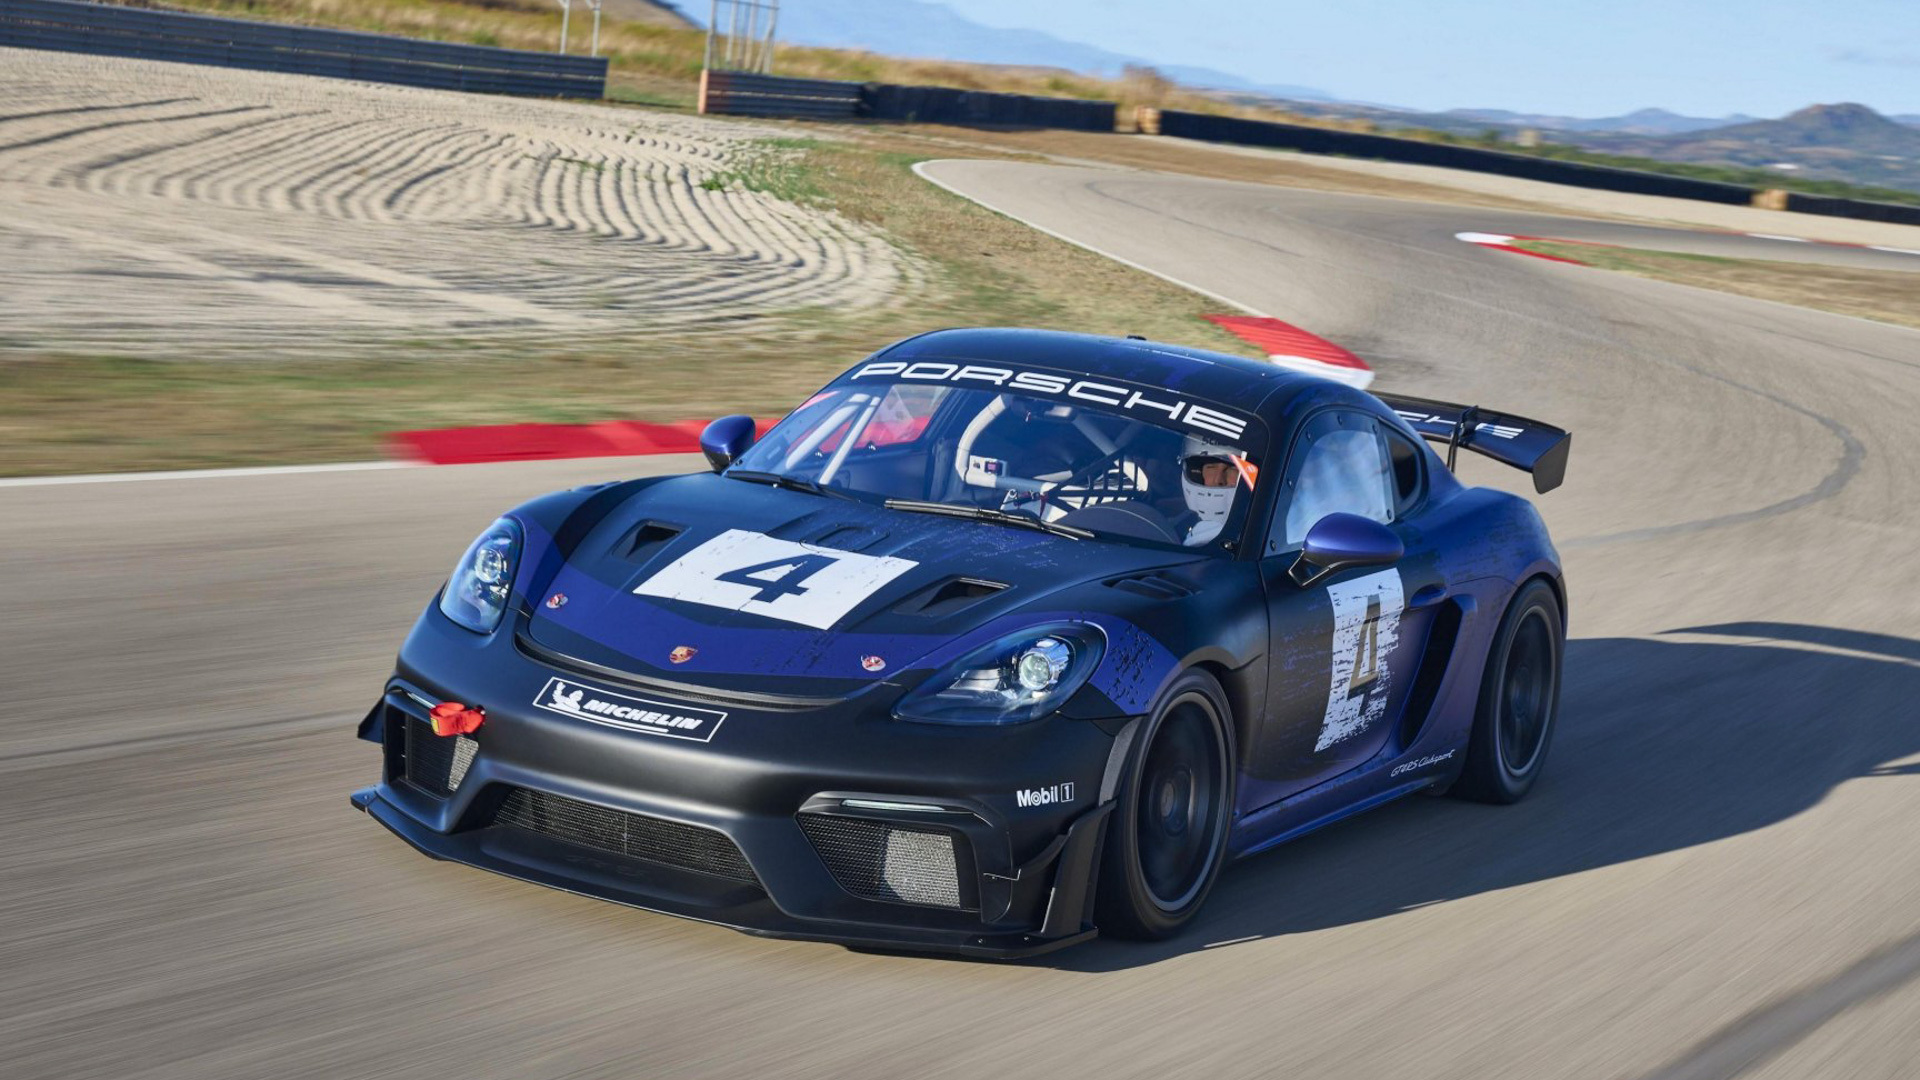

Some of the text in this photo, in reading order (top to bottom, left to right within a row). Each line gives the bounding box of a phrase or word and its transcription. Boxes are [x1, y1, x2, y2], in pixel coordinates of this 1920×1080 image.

[851, 362, 1247, 440] PORSCHE
[714, 554, 841, 603] 4
[1347, 594, 1381, 717] 4
[583, 700, 703, 730] MICHELIN
[1016, 785, 1058, 807] Mobil
